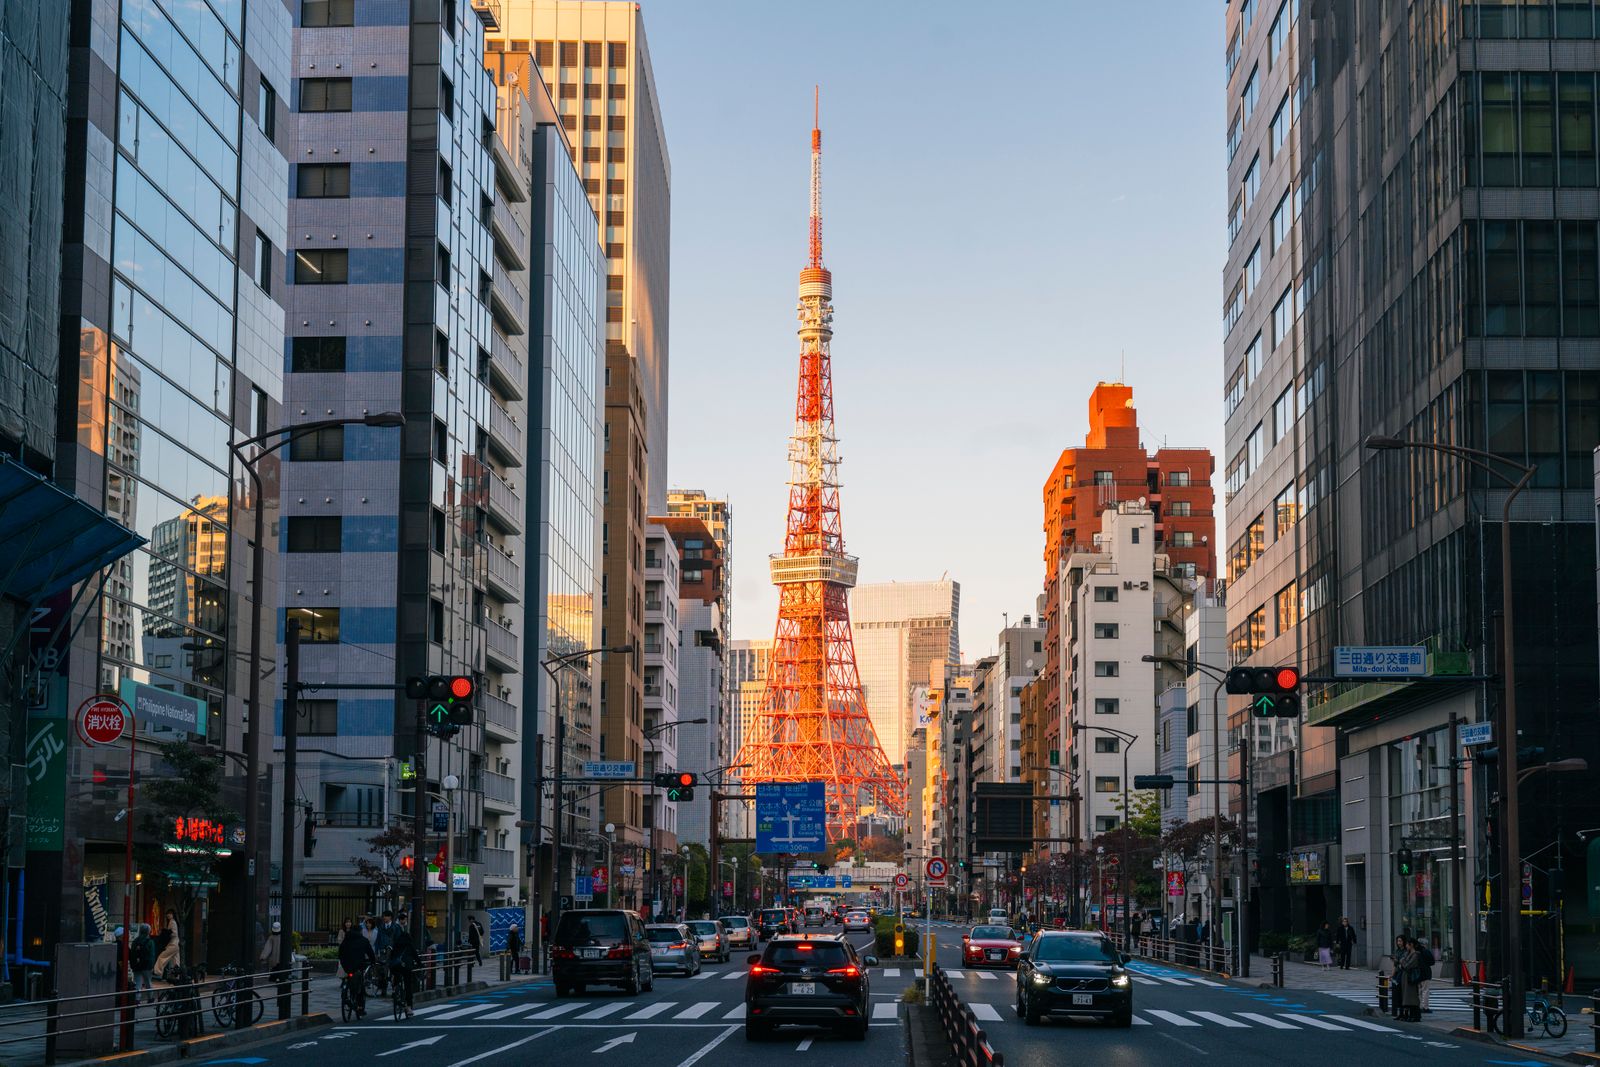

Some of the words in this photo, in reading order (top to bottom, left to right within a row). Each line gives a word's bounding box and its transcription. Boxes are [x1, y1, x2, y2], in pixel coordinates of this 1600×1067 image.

[1123, 581, 1149, 591] M-2
[1339, 652, 1421, 665] 三田通り交番前
[1352, 665, 1385, 673] Mita-dori
[1387, 665, 1409, 673] Koban
[142, 697, 166, 717] Philippine
[165, 704, 185, 721] National
[184, 709, 196, 724] Bank
[87, 714, 122, 731] 消火栓
